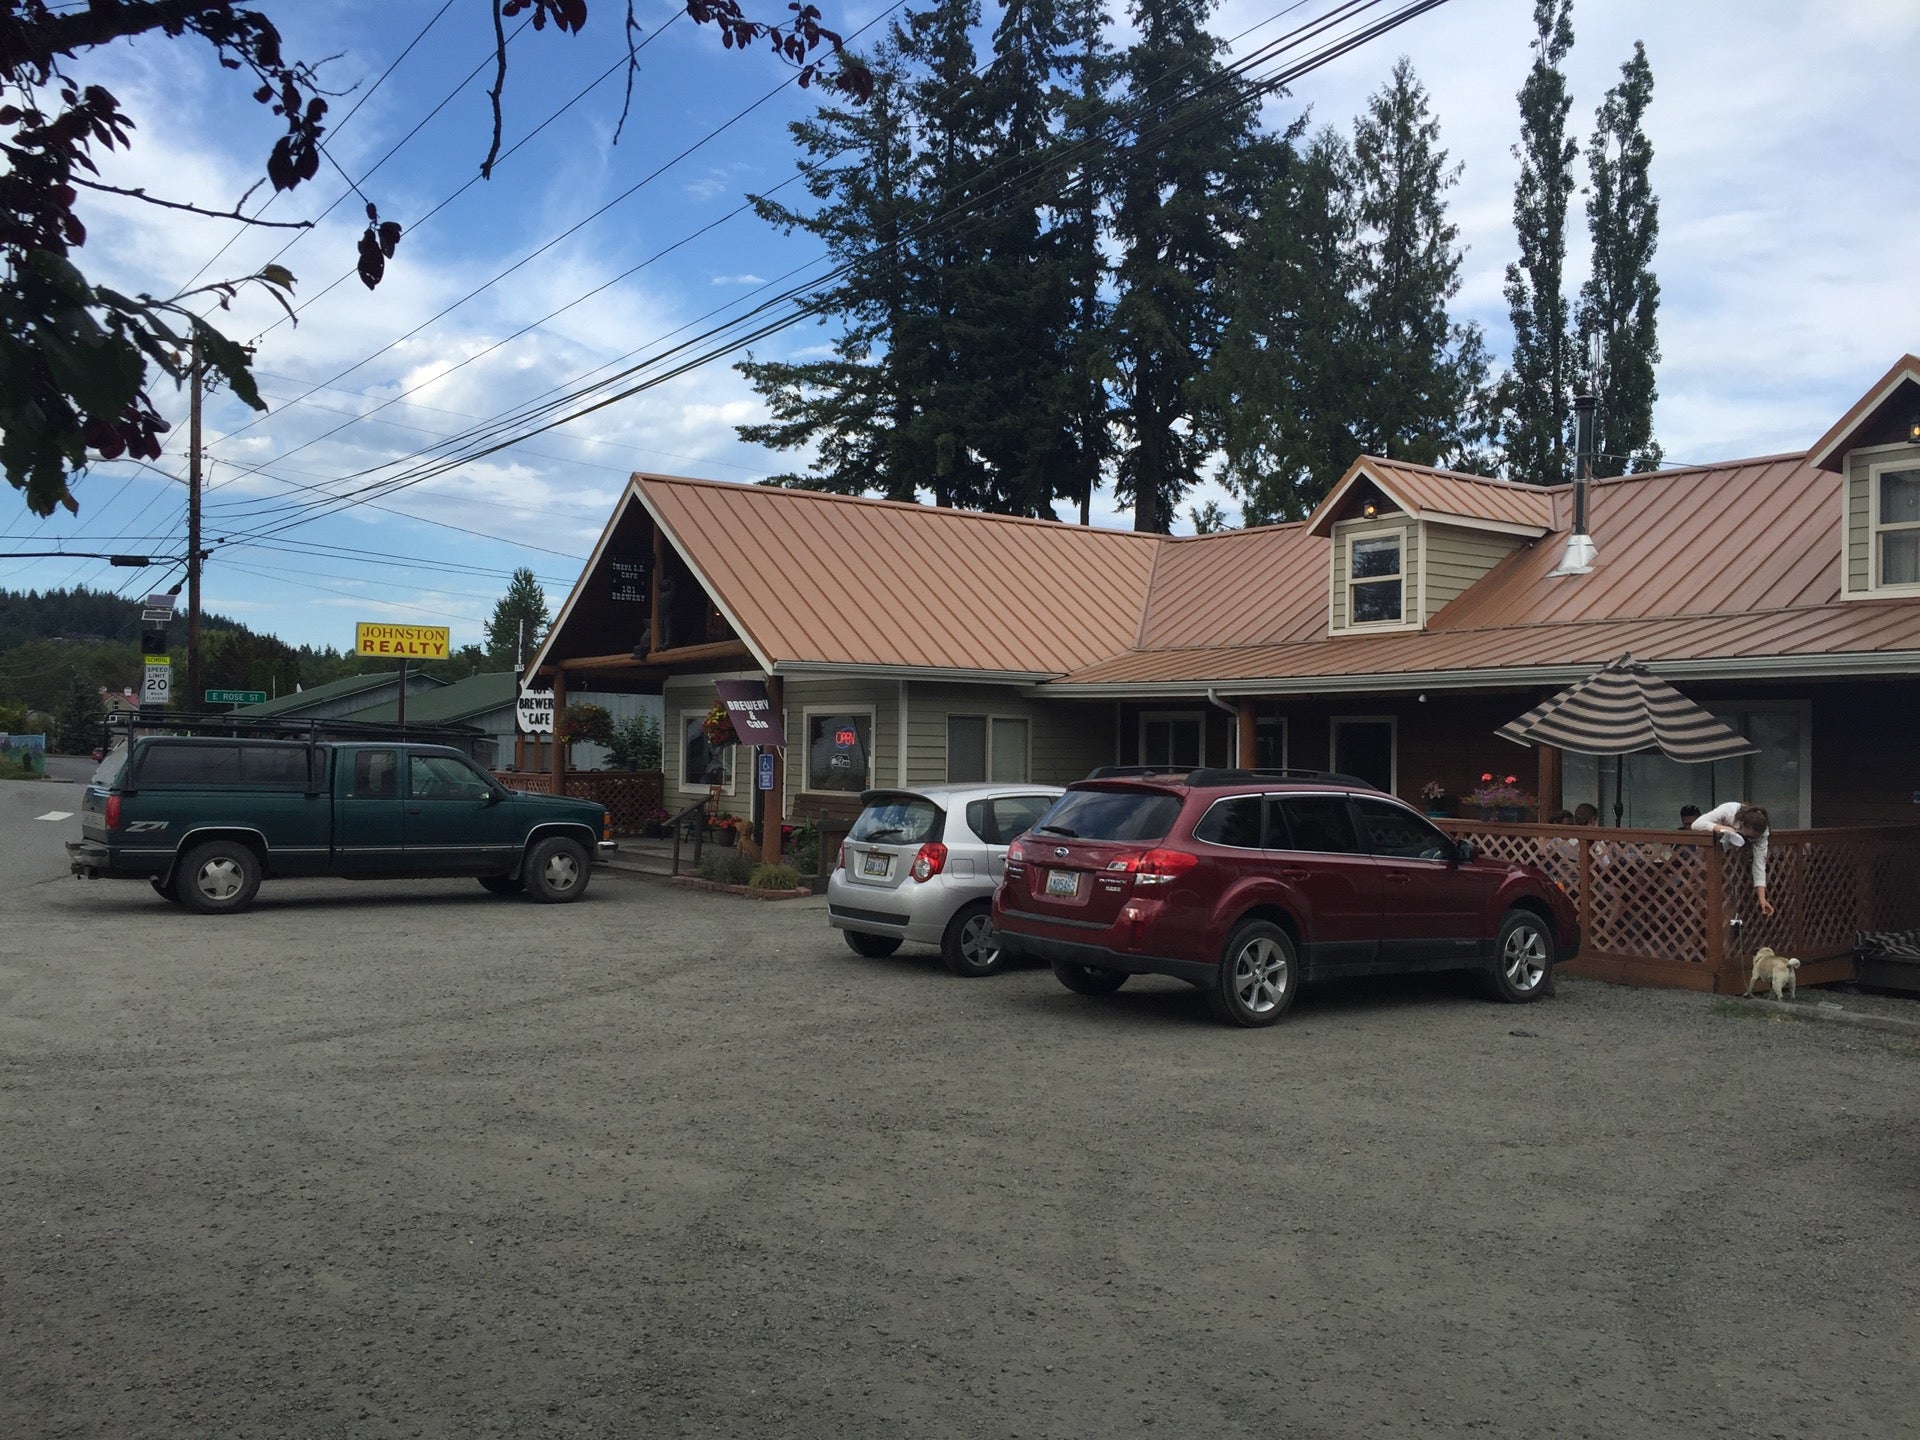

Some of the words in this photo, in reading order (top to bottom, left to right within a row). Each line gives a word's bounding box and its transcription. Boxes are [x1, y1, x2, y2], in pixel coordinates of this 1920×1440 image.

[622, 585, 636, 594] 101
[612, 592, 646, 602] BREWERY
[362, 626, 445, 641] JOHNSTON
[362, 640, 444, 655] REALTY
[147, 679, 167, 690] 20
[212, 692, 218, 700] E
[223, 693, 244, 701] ROSE
[519, 698, 554, 710] BREWER
[727, 699, 769, 711] BREWERY
[528, 713, 551, 725] CAFE
[748, 711, 757, 720] &
[835, 731, 856, 745] OPEN
[125, 820, 169, 832] Z71
